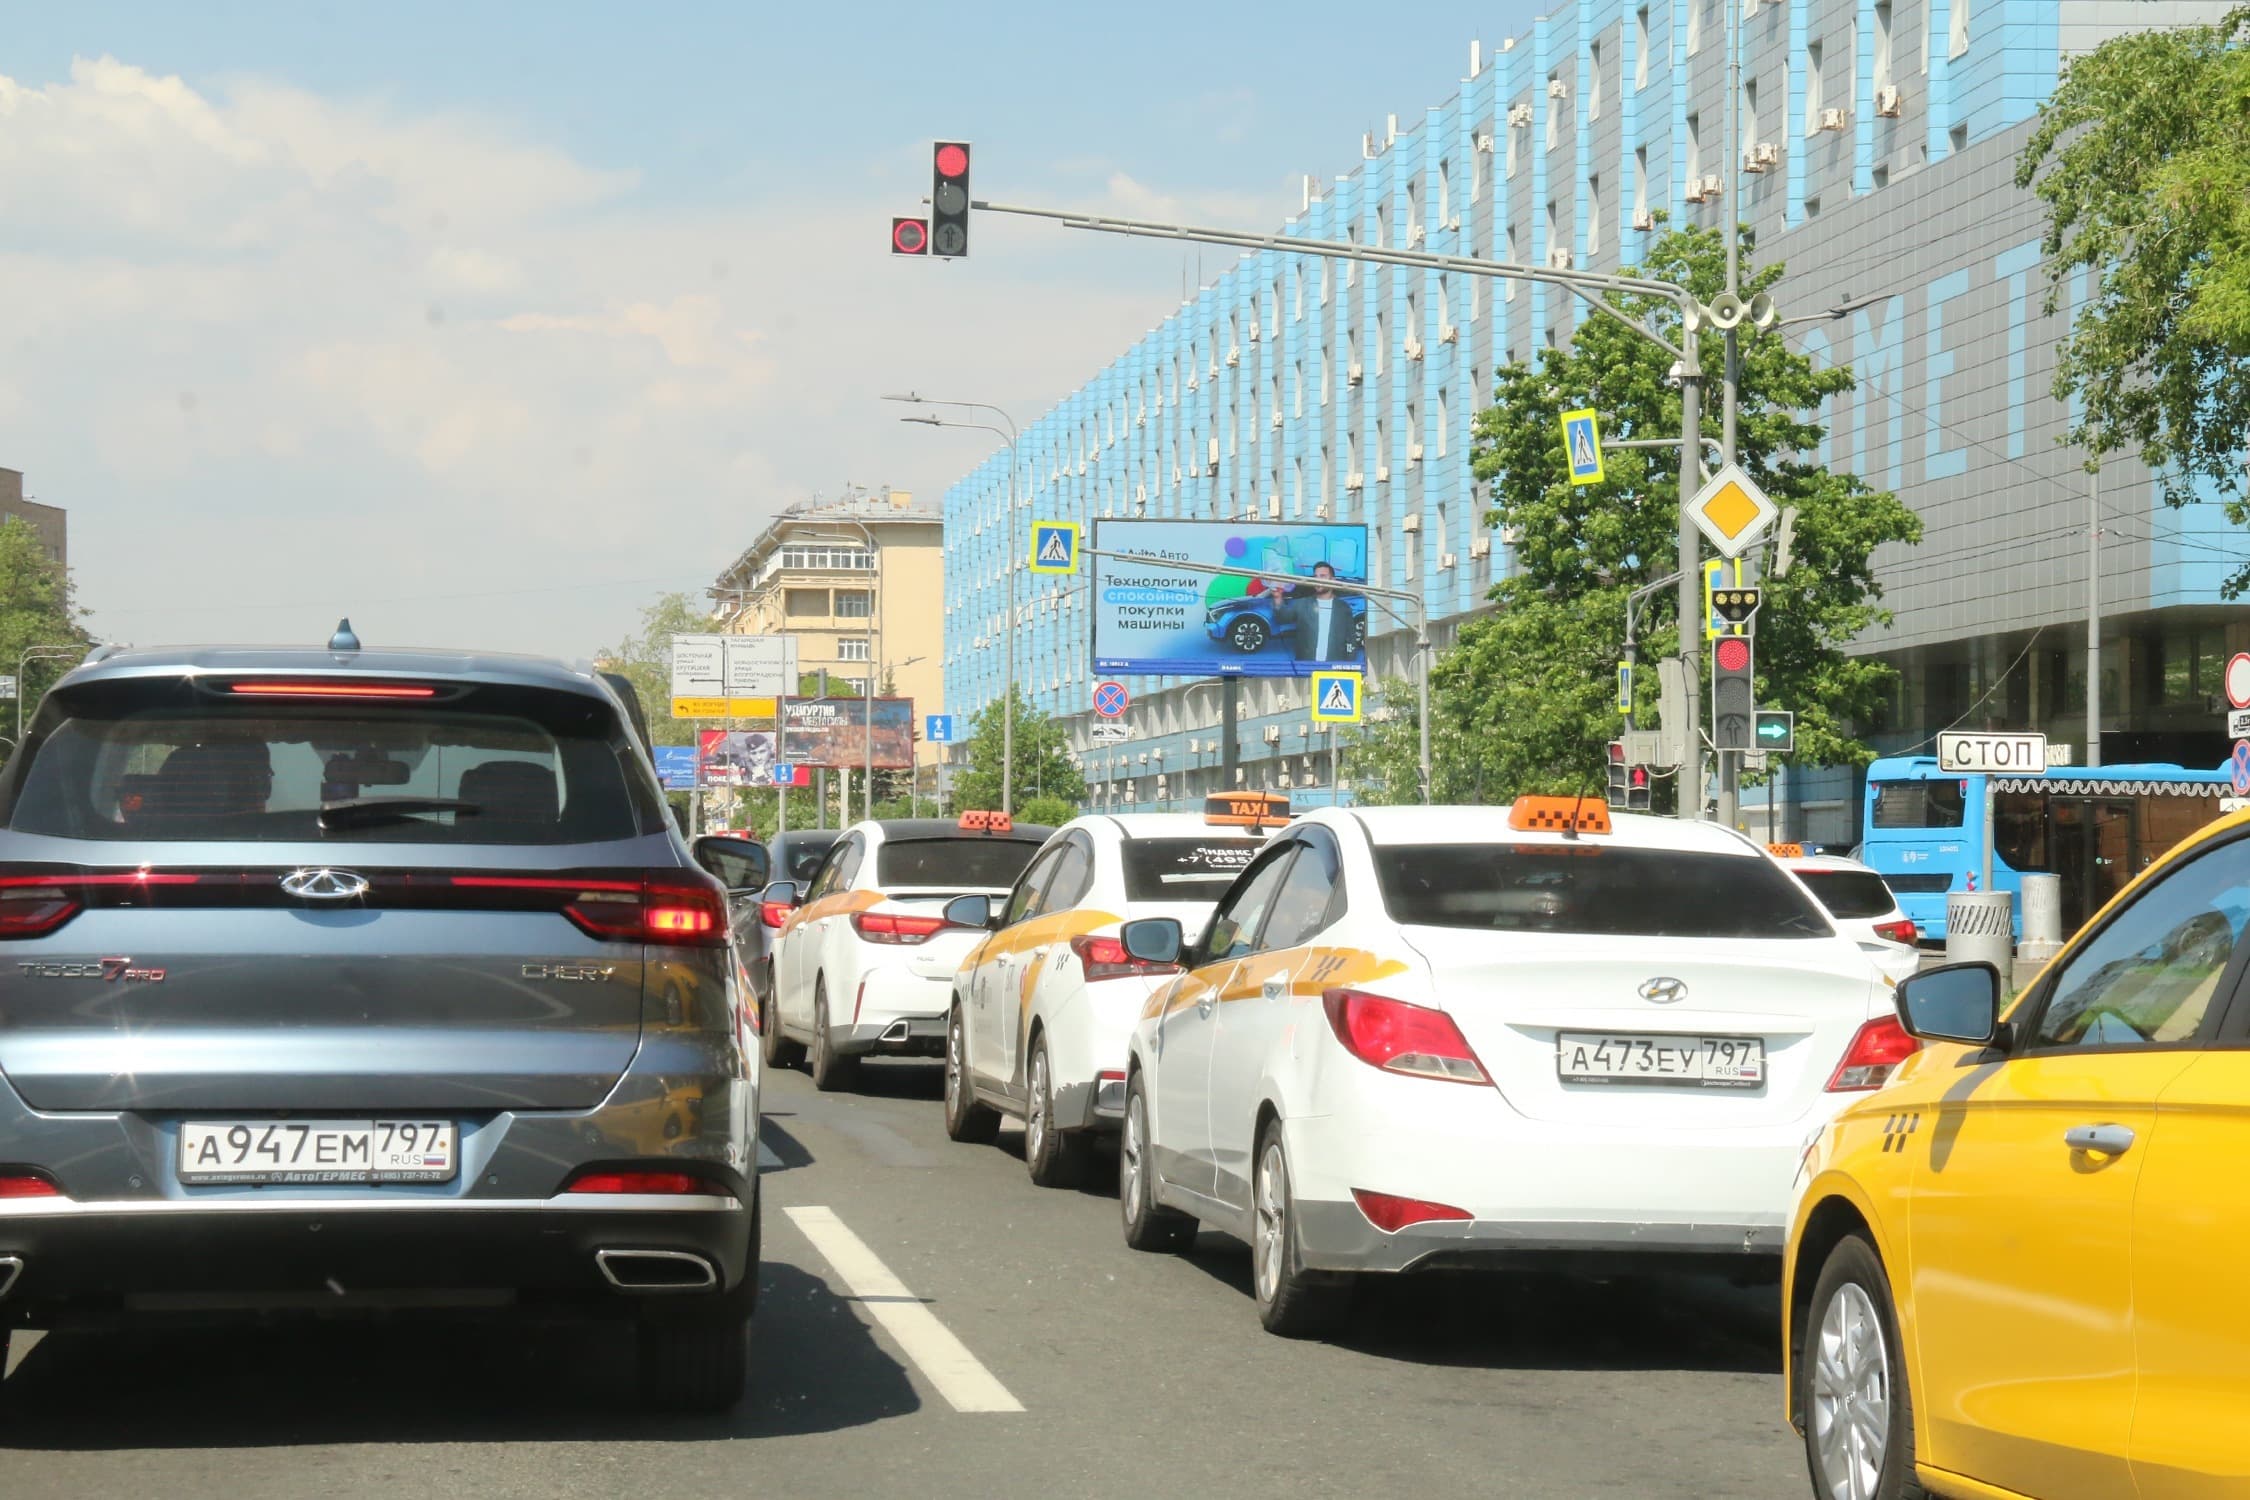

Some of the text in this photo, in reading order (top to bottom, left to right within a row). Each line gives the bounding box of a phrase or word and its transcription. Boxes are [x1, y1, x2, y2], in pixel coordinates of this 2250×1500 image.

[1104, 575, 1198, 587] Технологии
[1108, 589, 1195, 601] спокойной
[1118, 606, 1185, 618] покупки
[1118, 620, 1185, 630] машины
[784, 704, 836, 718] УДМУРТИЯ
[1955, 740, 2032, 766] СТОП
[1229, 801, 1269, 816] TAXI
[1197, 847, 1252, 857] Яндекс
[522, 964, 617, 981] CHERY
[1571, 1039, 1752, 1073] А473ЕУ 797
[1715, 1066, 1739, 1076] RUS
[197, 1122, 441, 1165] А947ЕМ 797
[391, 1154, 422, 1165] RUS
[284, 1171, 366, 1182] АвтоГЕРМЕС
